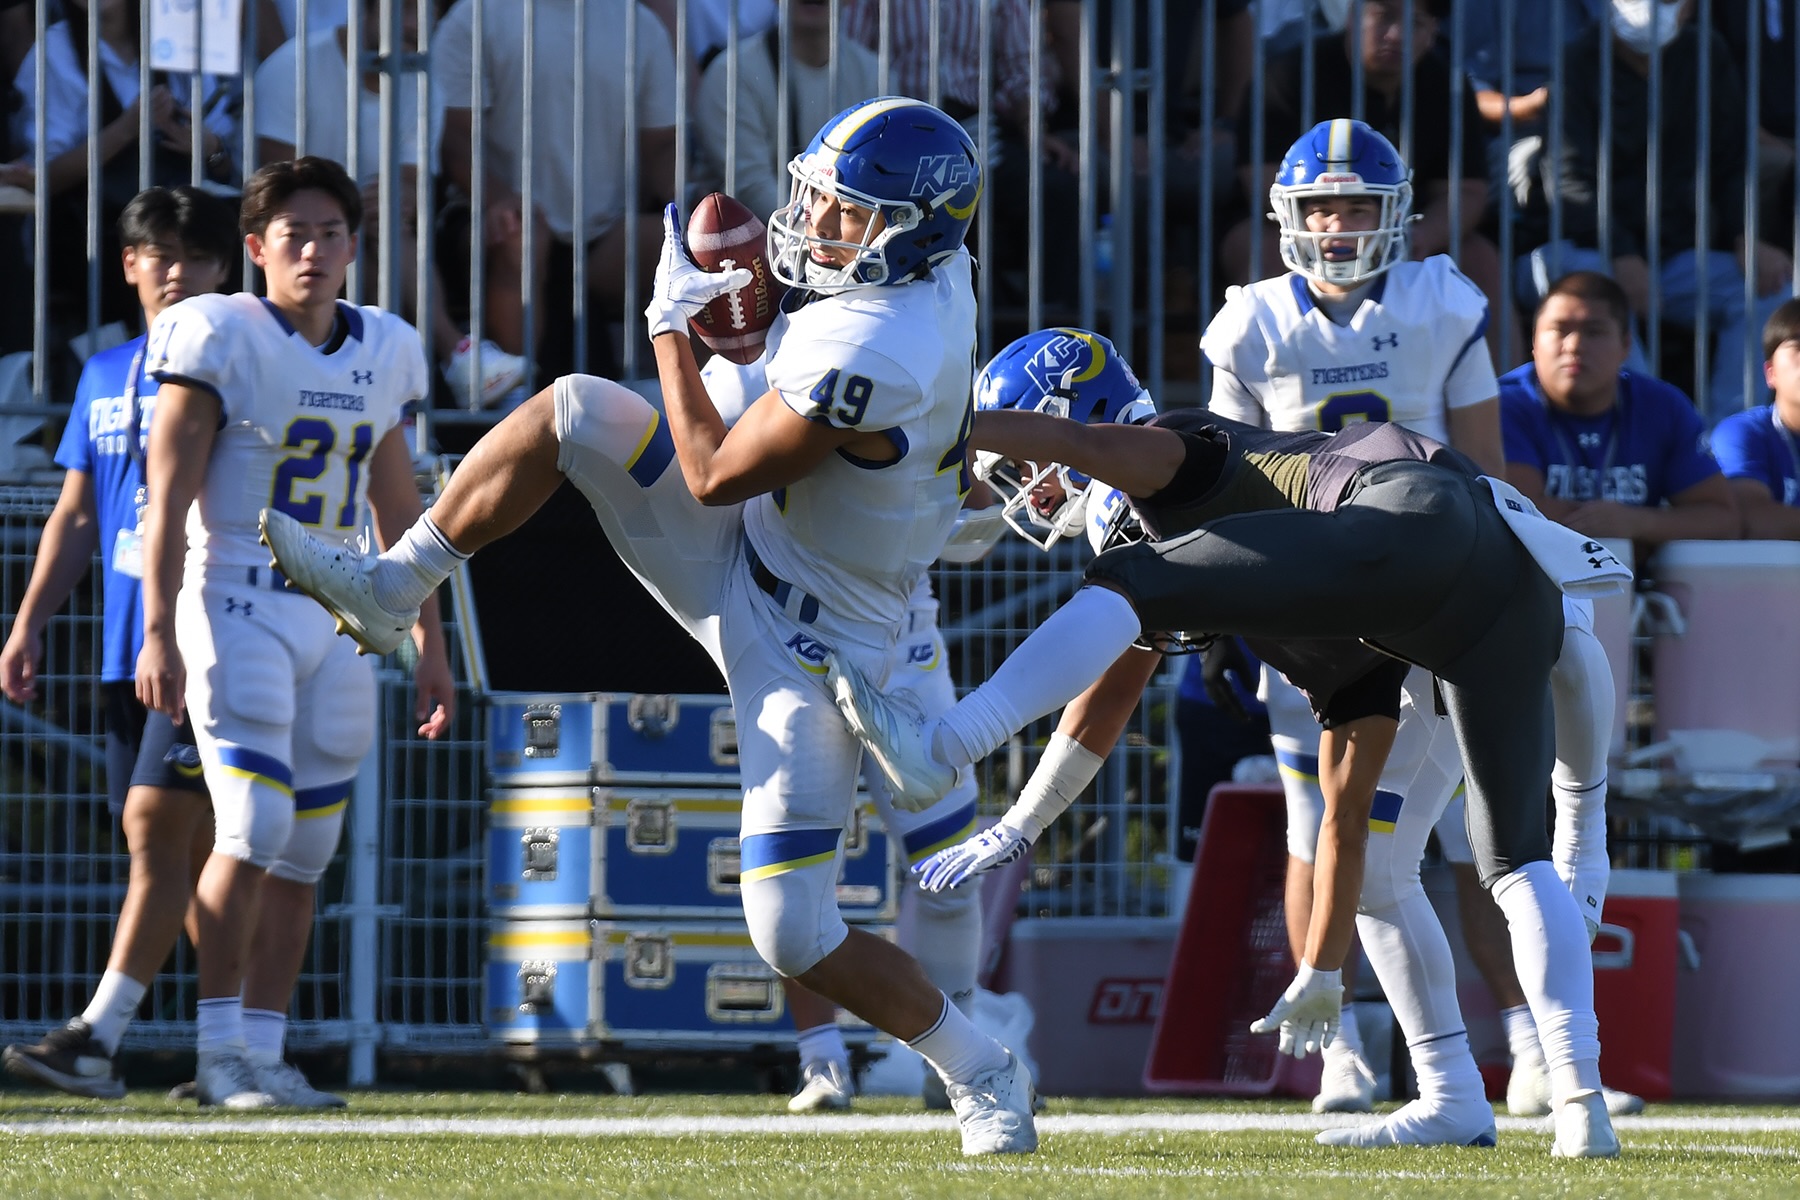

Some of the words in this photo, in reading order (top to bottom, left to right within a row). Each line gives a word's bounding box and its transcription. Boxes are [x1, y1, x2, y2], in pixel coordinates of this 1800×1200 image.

[751, 256, 770, 320] Wilson
[1311, 361, 1389, 385] FIGHTERS
[298, 390, 364, 412] FIGHTERS
[808, 366, 875, 427] 49
[269, 414, 375, 531] 21
[784, 631, 832, 663] KG
